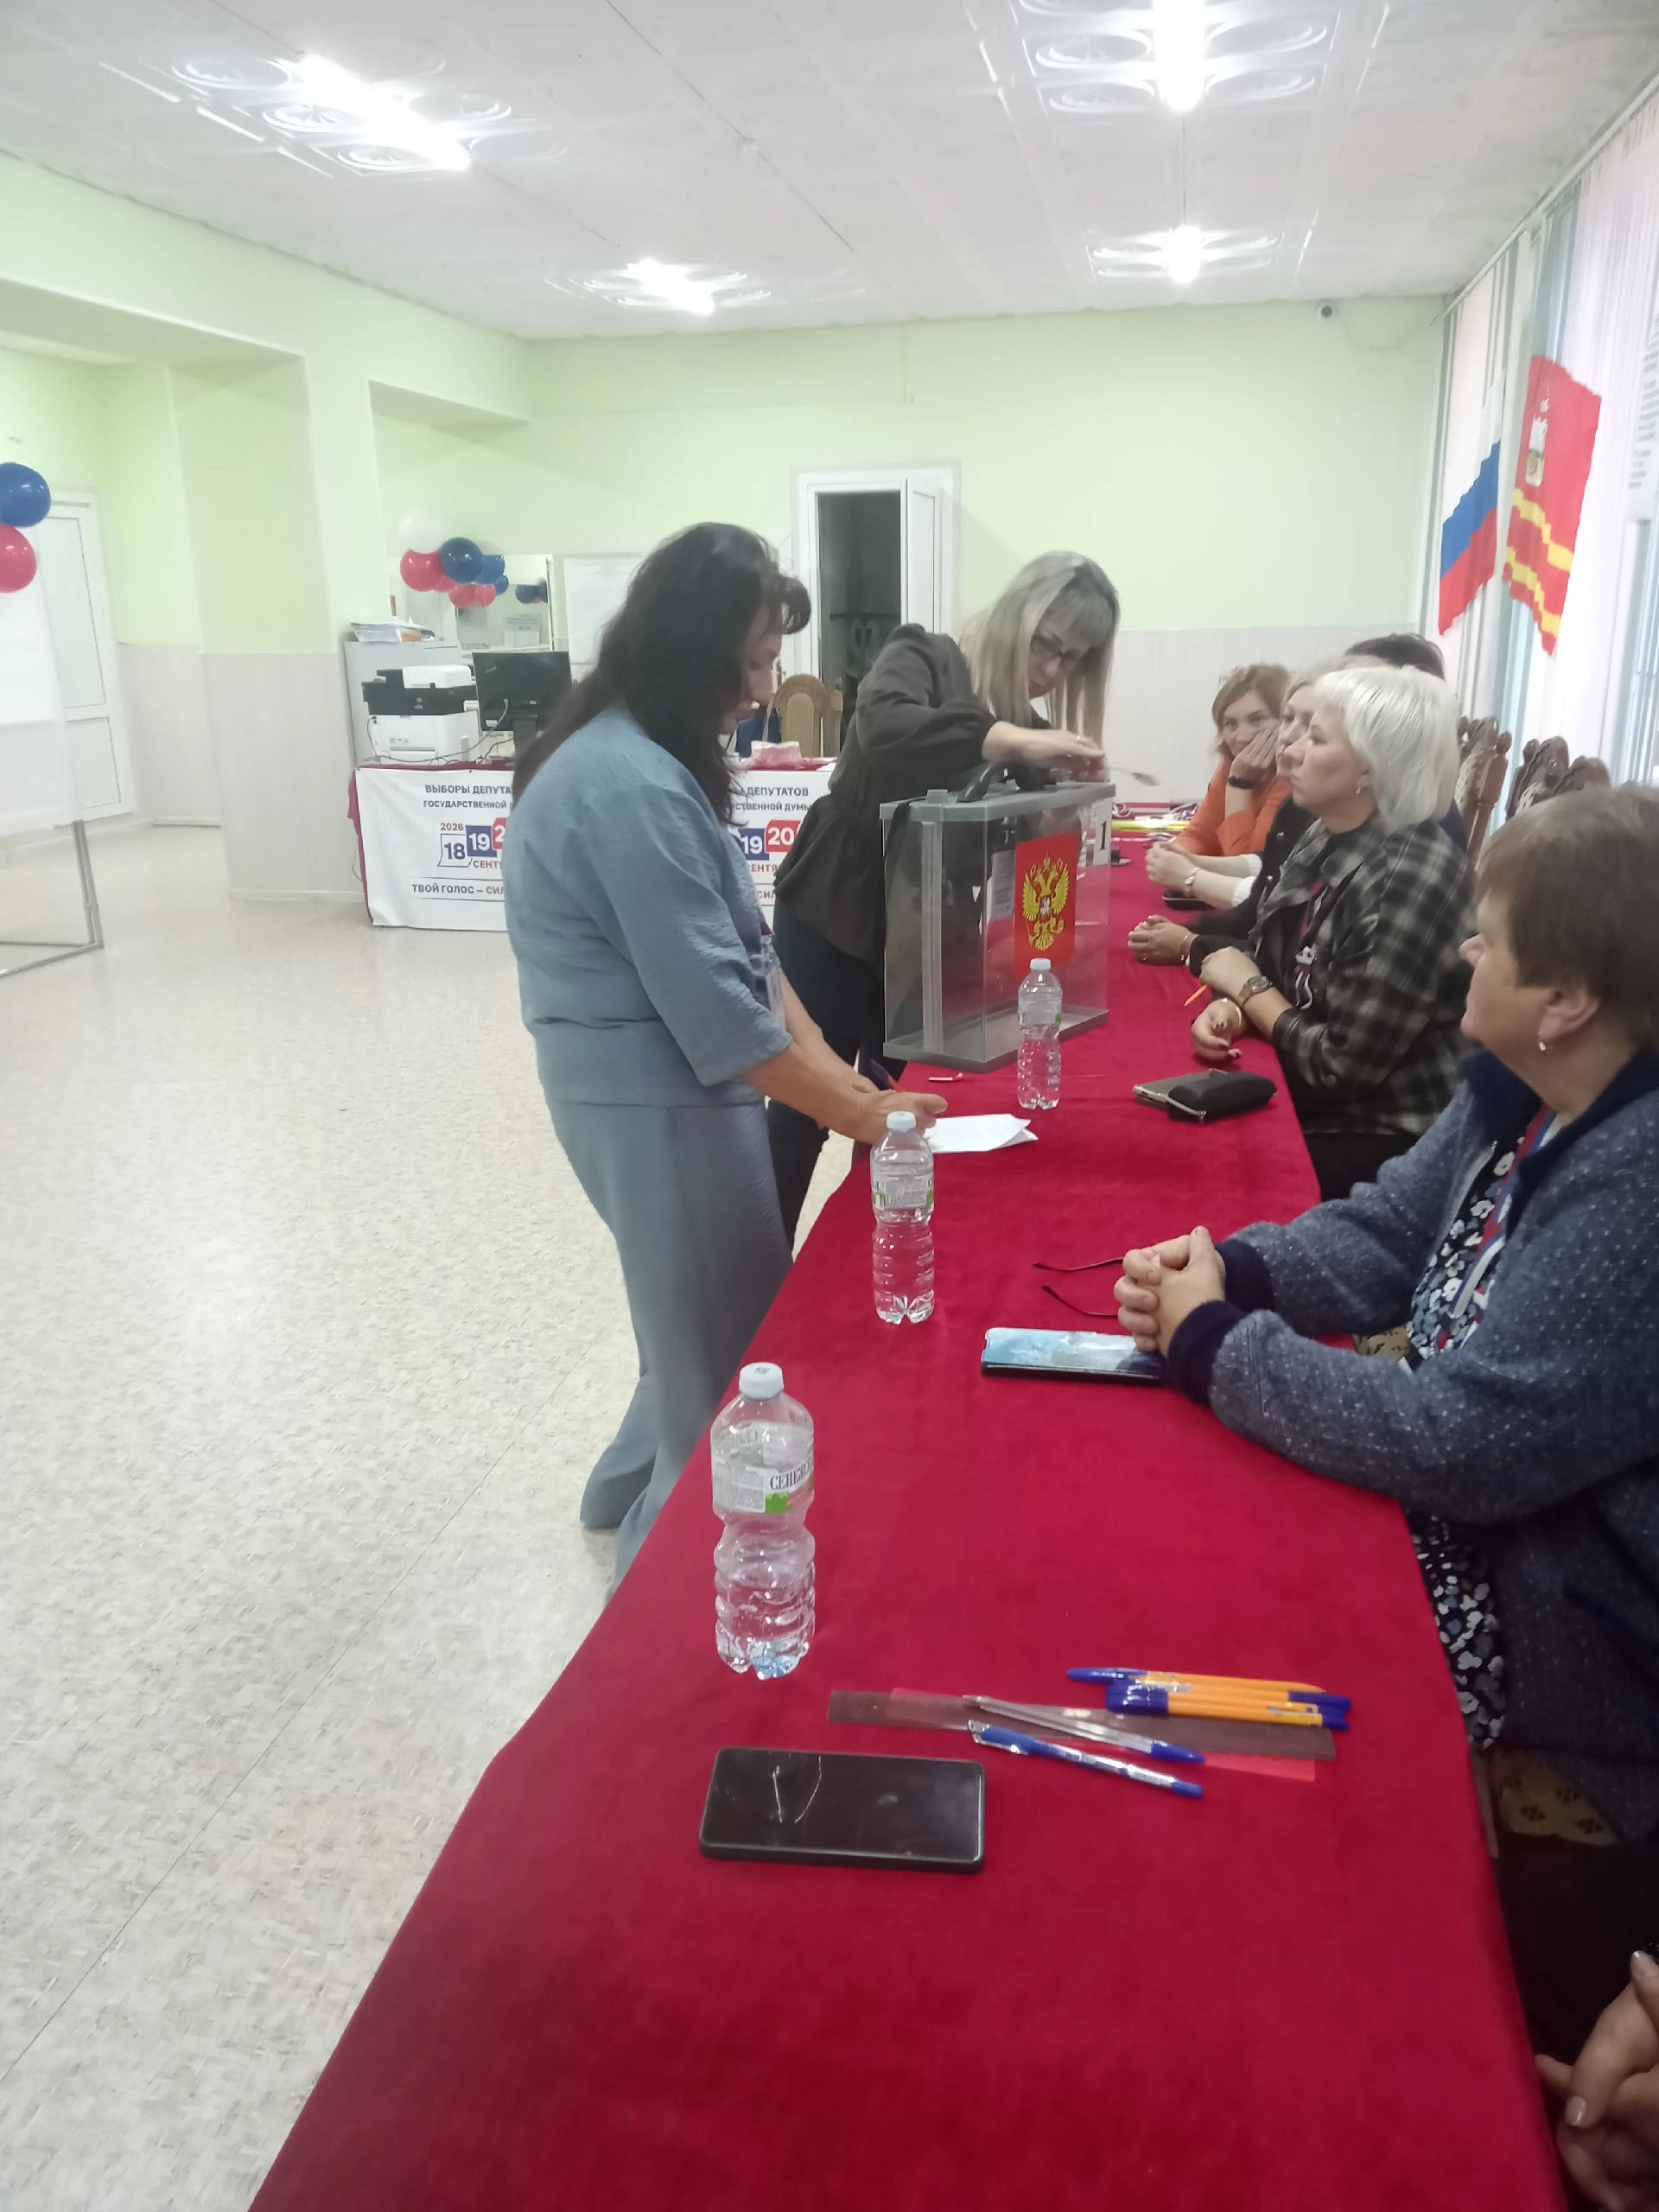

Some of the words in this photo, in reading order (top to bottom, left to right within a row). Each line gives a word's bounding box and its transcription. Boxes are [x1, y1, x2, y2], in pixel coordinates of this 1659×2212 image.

[425, 785, 470, 794] ВЫБОРЫ
[473, 785, 512, 795] ДЕПУТА
[747, 786, 809, 797] ДЕПУТАТОВ
[423, 800, 507, 809] ГОСУДАРСТВЕННОЙ
[735, 801, 783, 810] СТВЕННОЙ
[440, 823, 464, 831] 2026
[1100, 820, 1107, 850] 1
[443, 842, 466, 860] 18
[468, 832, 491, 851] 19
[493, 824, 506, 842] 2
[741, 835, 763, 855] 19
[767, 826, 795, 846] 20
[473, 860, 502, 869] СЕНТ
[751, 863, 778, 873] ЕНТЯ
[412, 882, 439, 893] ТВОЙ
[442, 885, 474, 894] ГОЛОС
